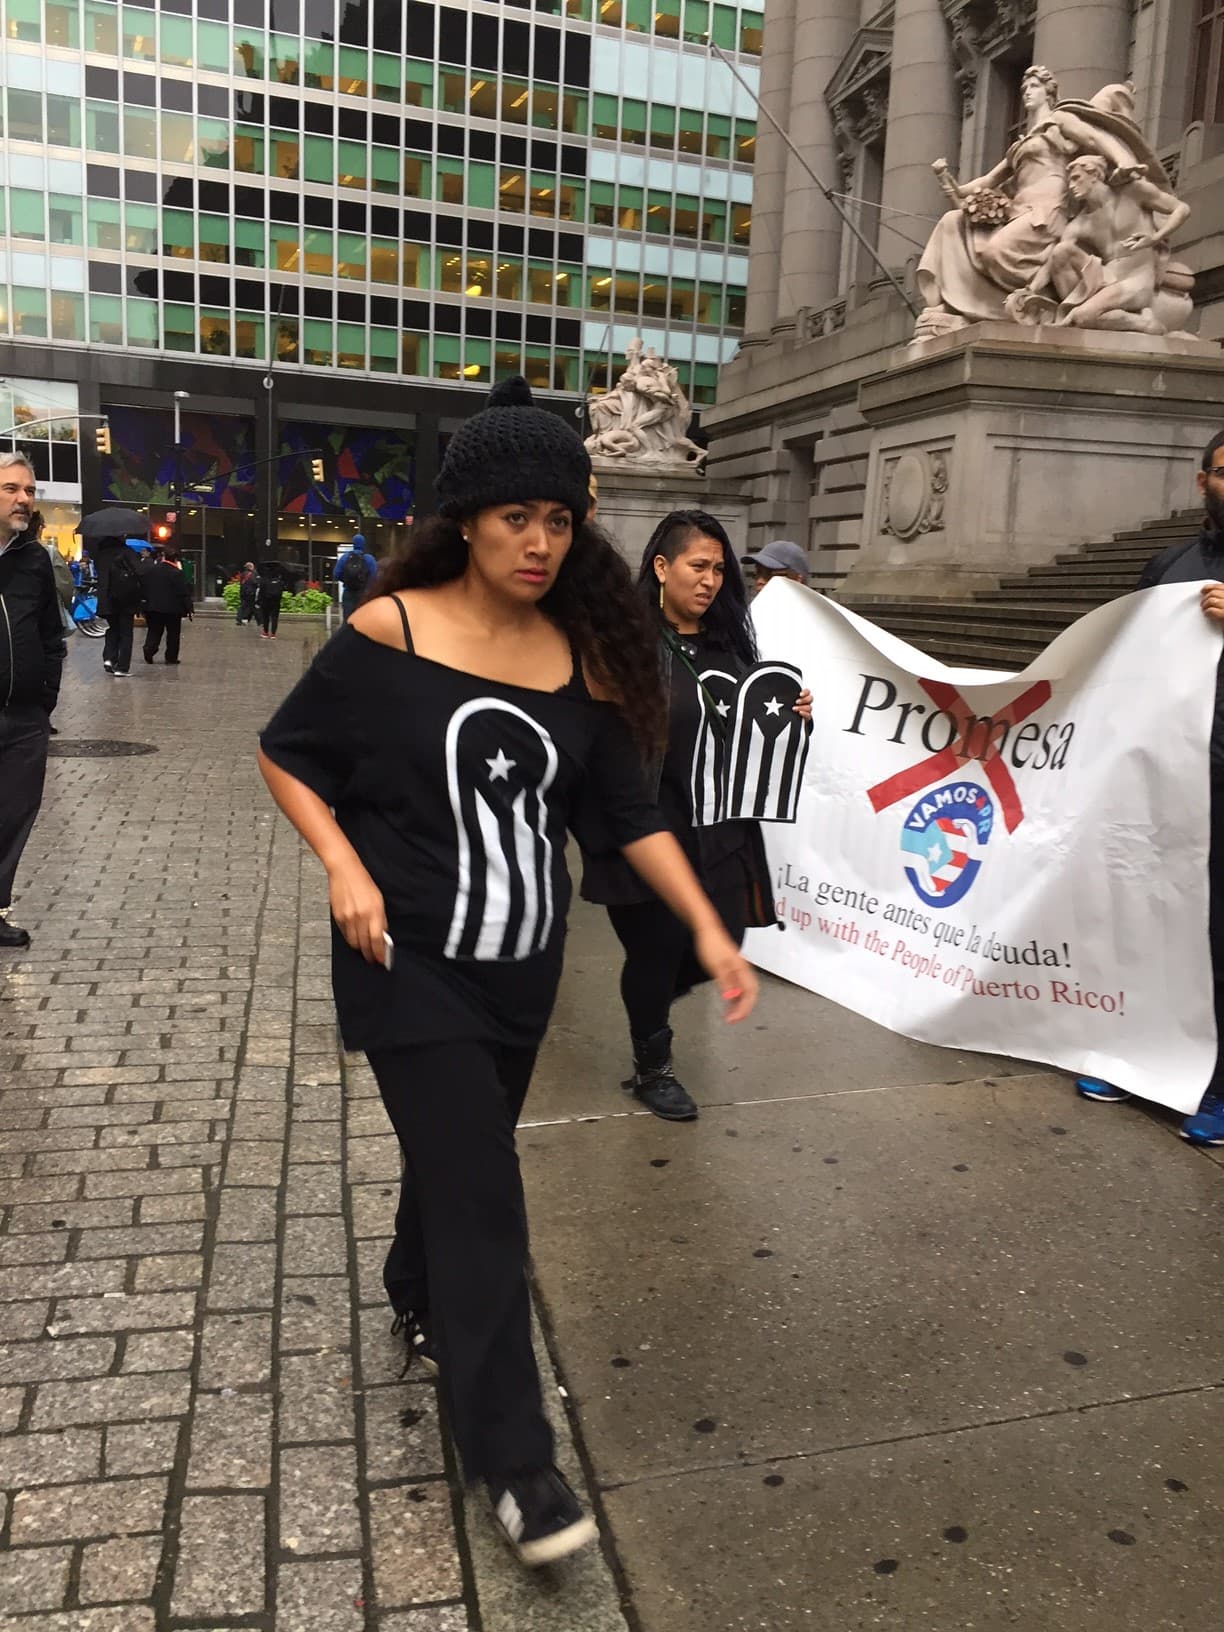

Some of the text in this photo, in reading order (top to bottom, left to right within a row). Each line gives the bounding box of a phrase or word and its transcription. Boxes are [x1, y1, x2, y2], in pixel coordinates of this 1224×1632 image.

[843, 673, 1075, 770] Promesa
[777, 864, 809, 893] ¡La
[814, 881, 879, 914] gente
[883, 903, 932, 934] antes
[933, 920, 965, 947] que
[965, 925, 982, 954] la
[982, 931, 1072, 968] deuda!
[791, 906, 812, 931] up
[817, 917, 860, 945] with
[864, 930, 890, 956] the
[890, 940, 942, 978] People
[943, 965, 965, 988] of
[960, 968, 1040, 1001] Puerto
[1049, 980, 1125, 1017] Rico!
